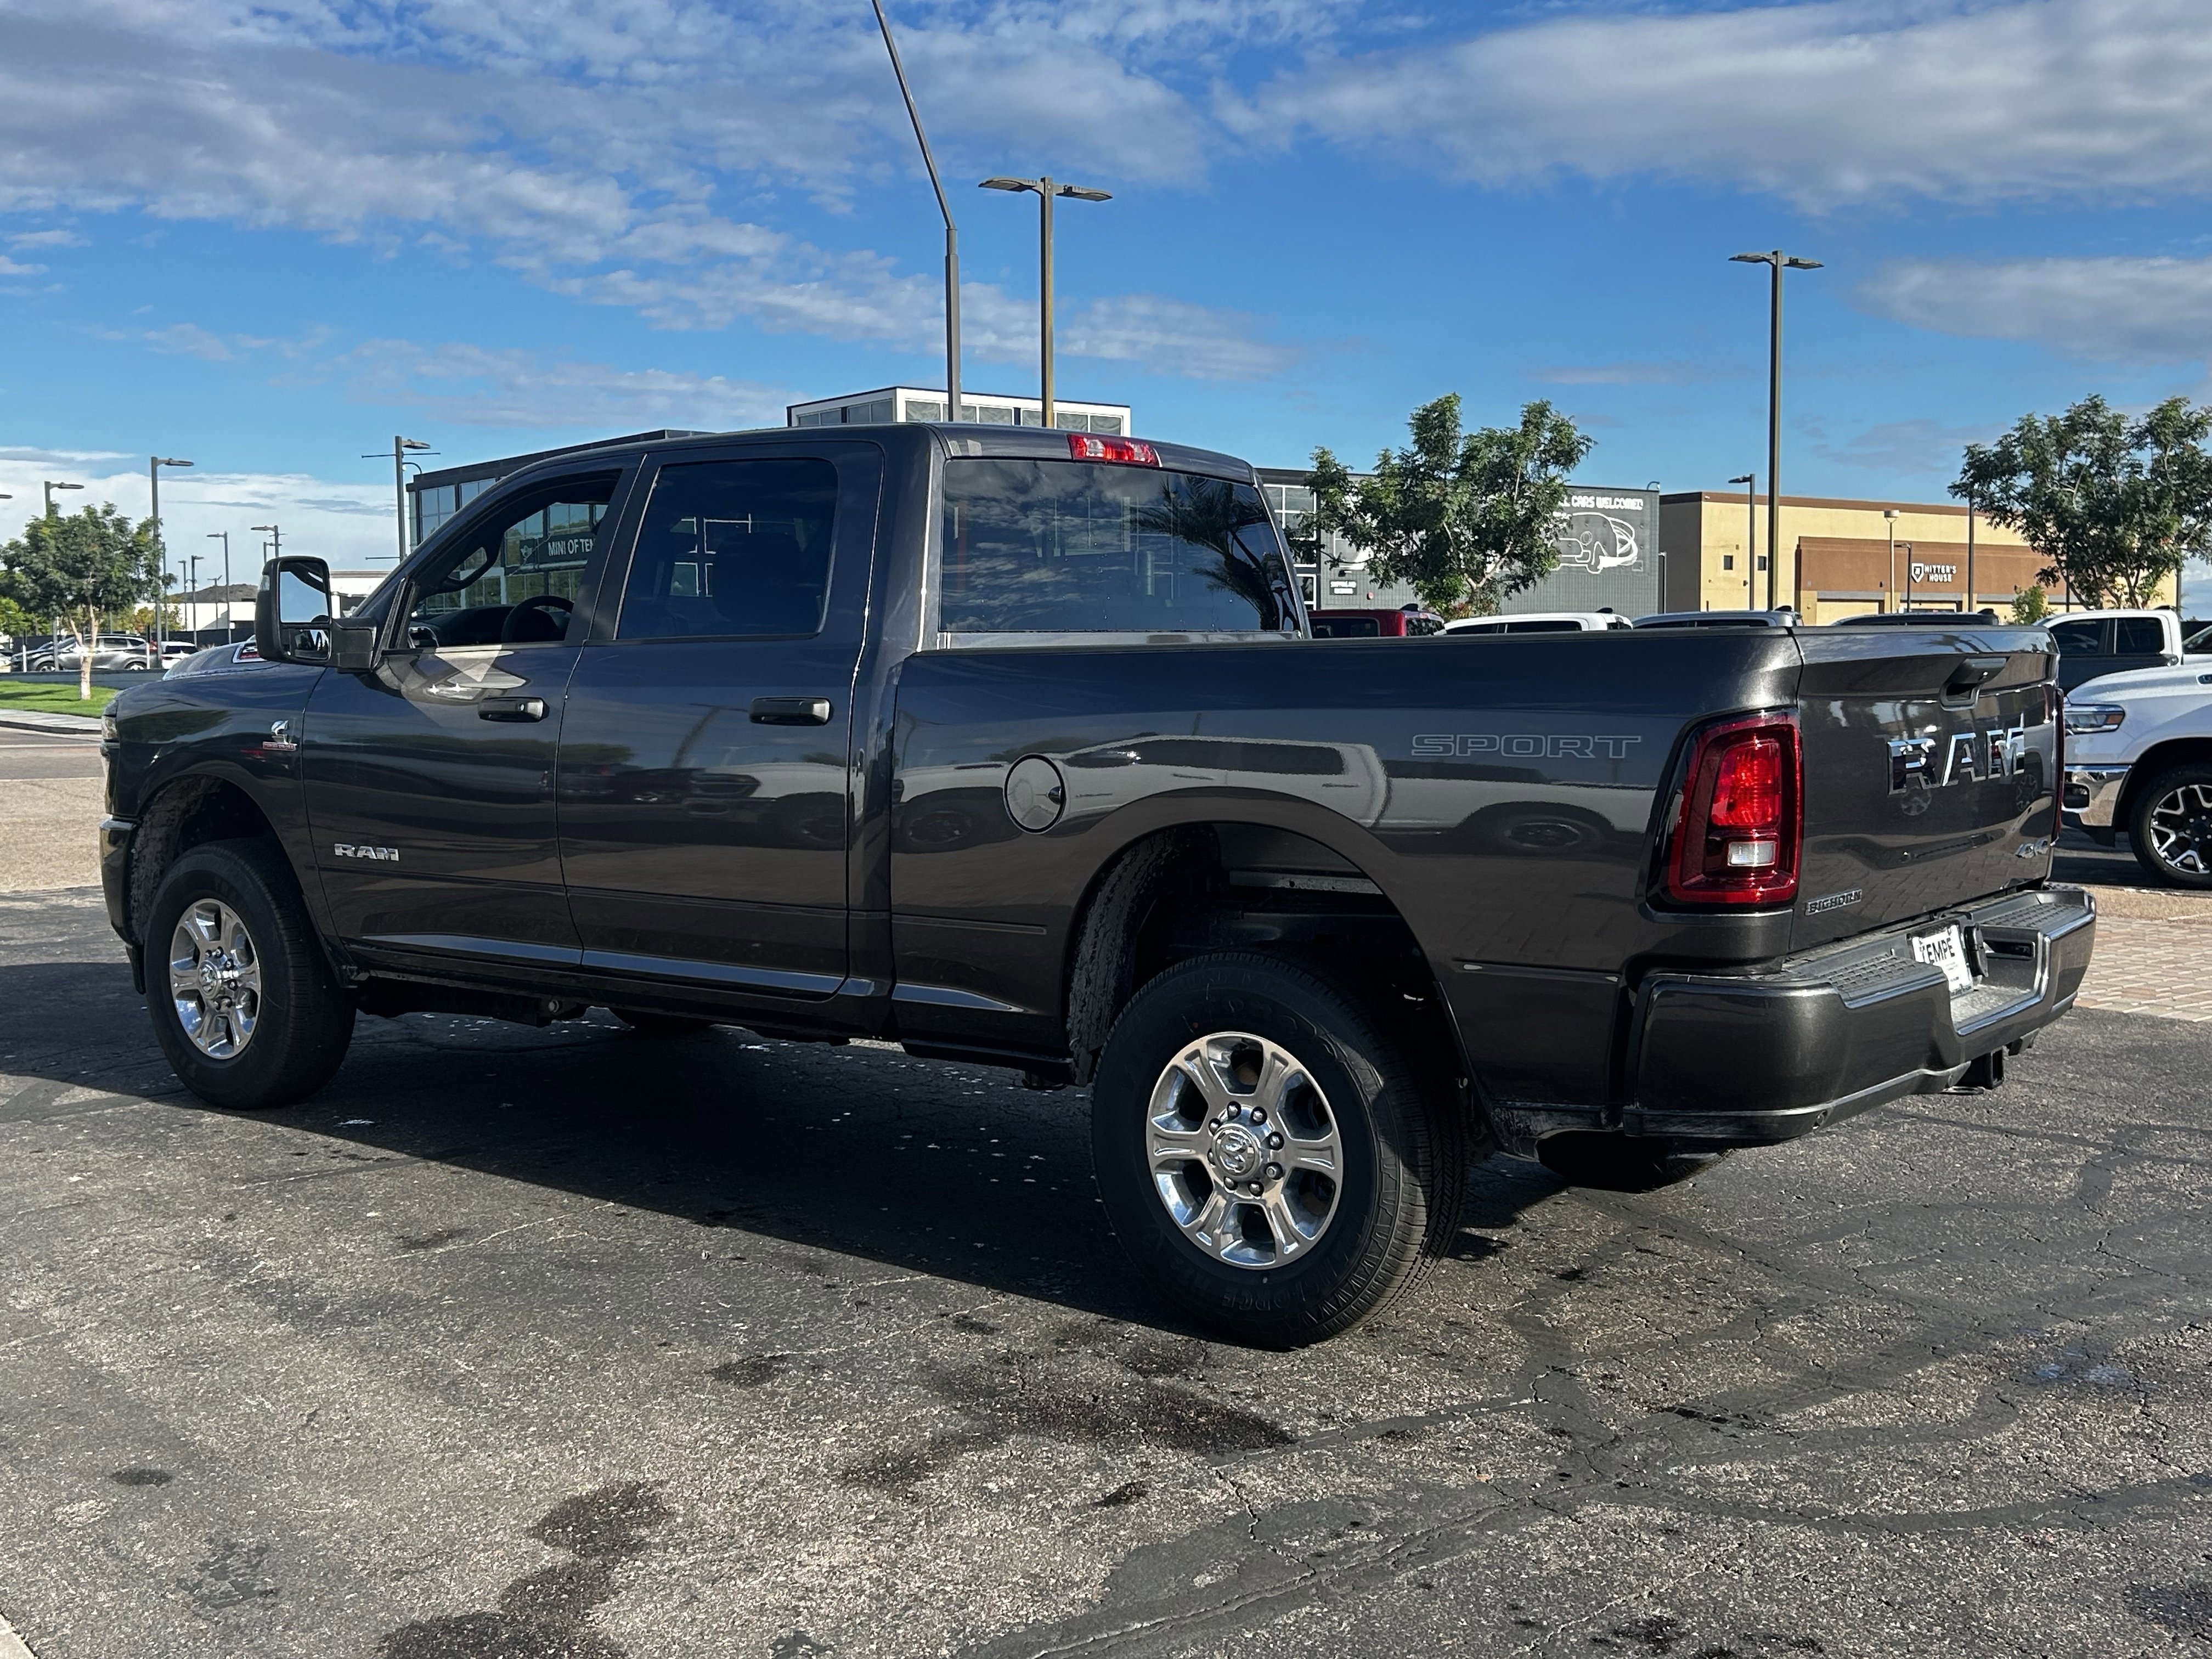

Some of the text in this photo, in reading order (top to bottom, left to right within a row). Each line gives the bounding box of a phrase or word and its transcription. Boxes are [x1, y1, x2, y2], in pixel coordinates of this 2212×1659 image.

[1571, 495, 1595, 509] CARS
[549, 540, 566, 556] MINI
[567, 539, 579, 555] OF
[1925, 565, 1957, 574] HITTER'S
[1928, 573, 1953, 582] HOUSE
[1411, 734, 1641, 759] SPORT
[1887, 729, 2024, 795] RAM
[334, 843, 399, 861] RAM
[1807, 889, 1861, 914] BIGHORN
[1919, 936, 1956, 964] TEMPE
